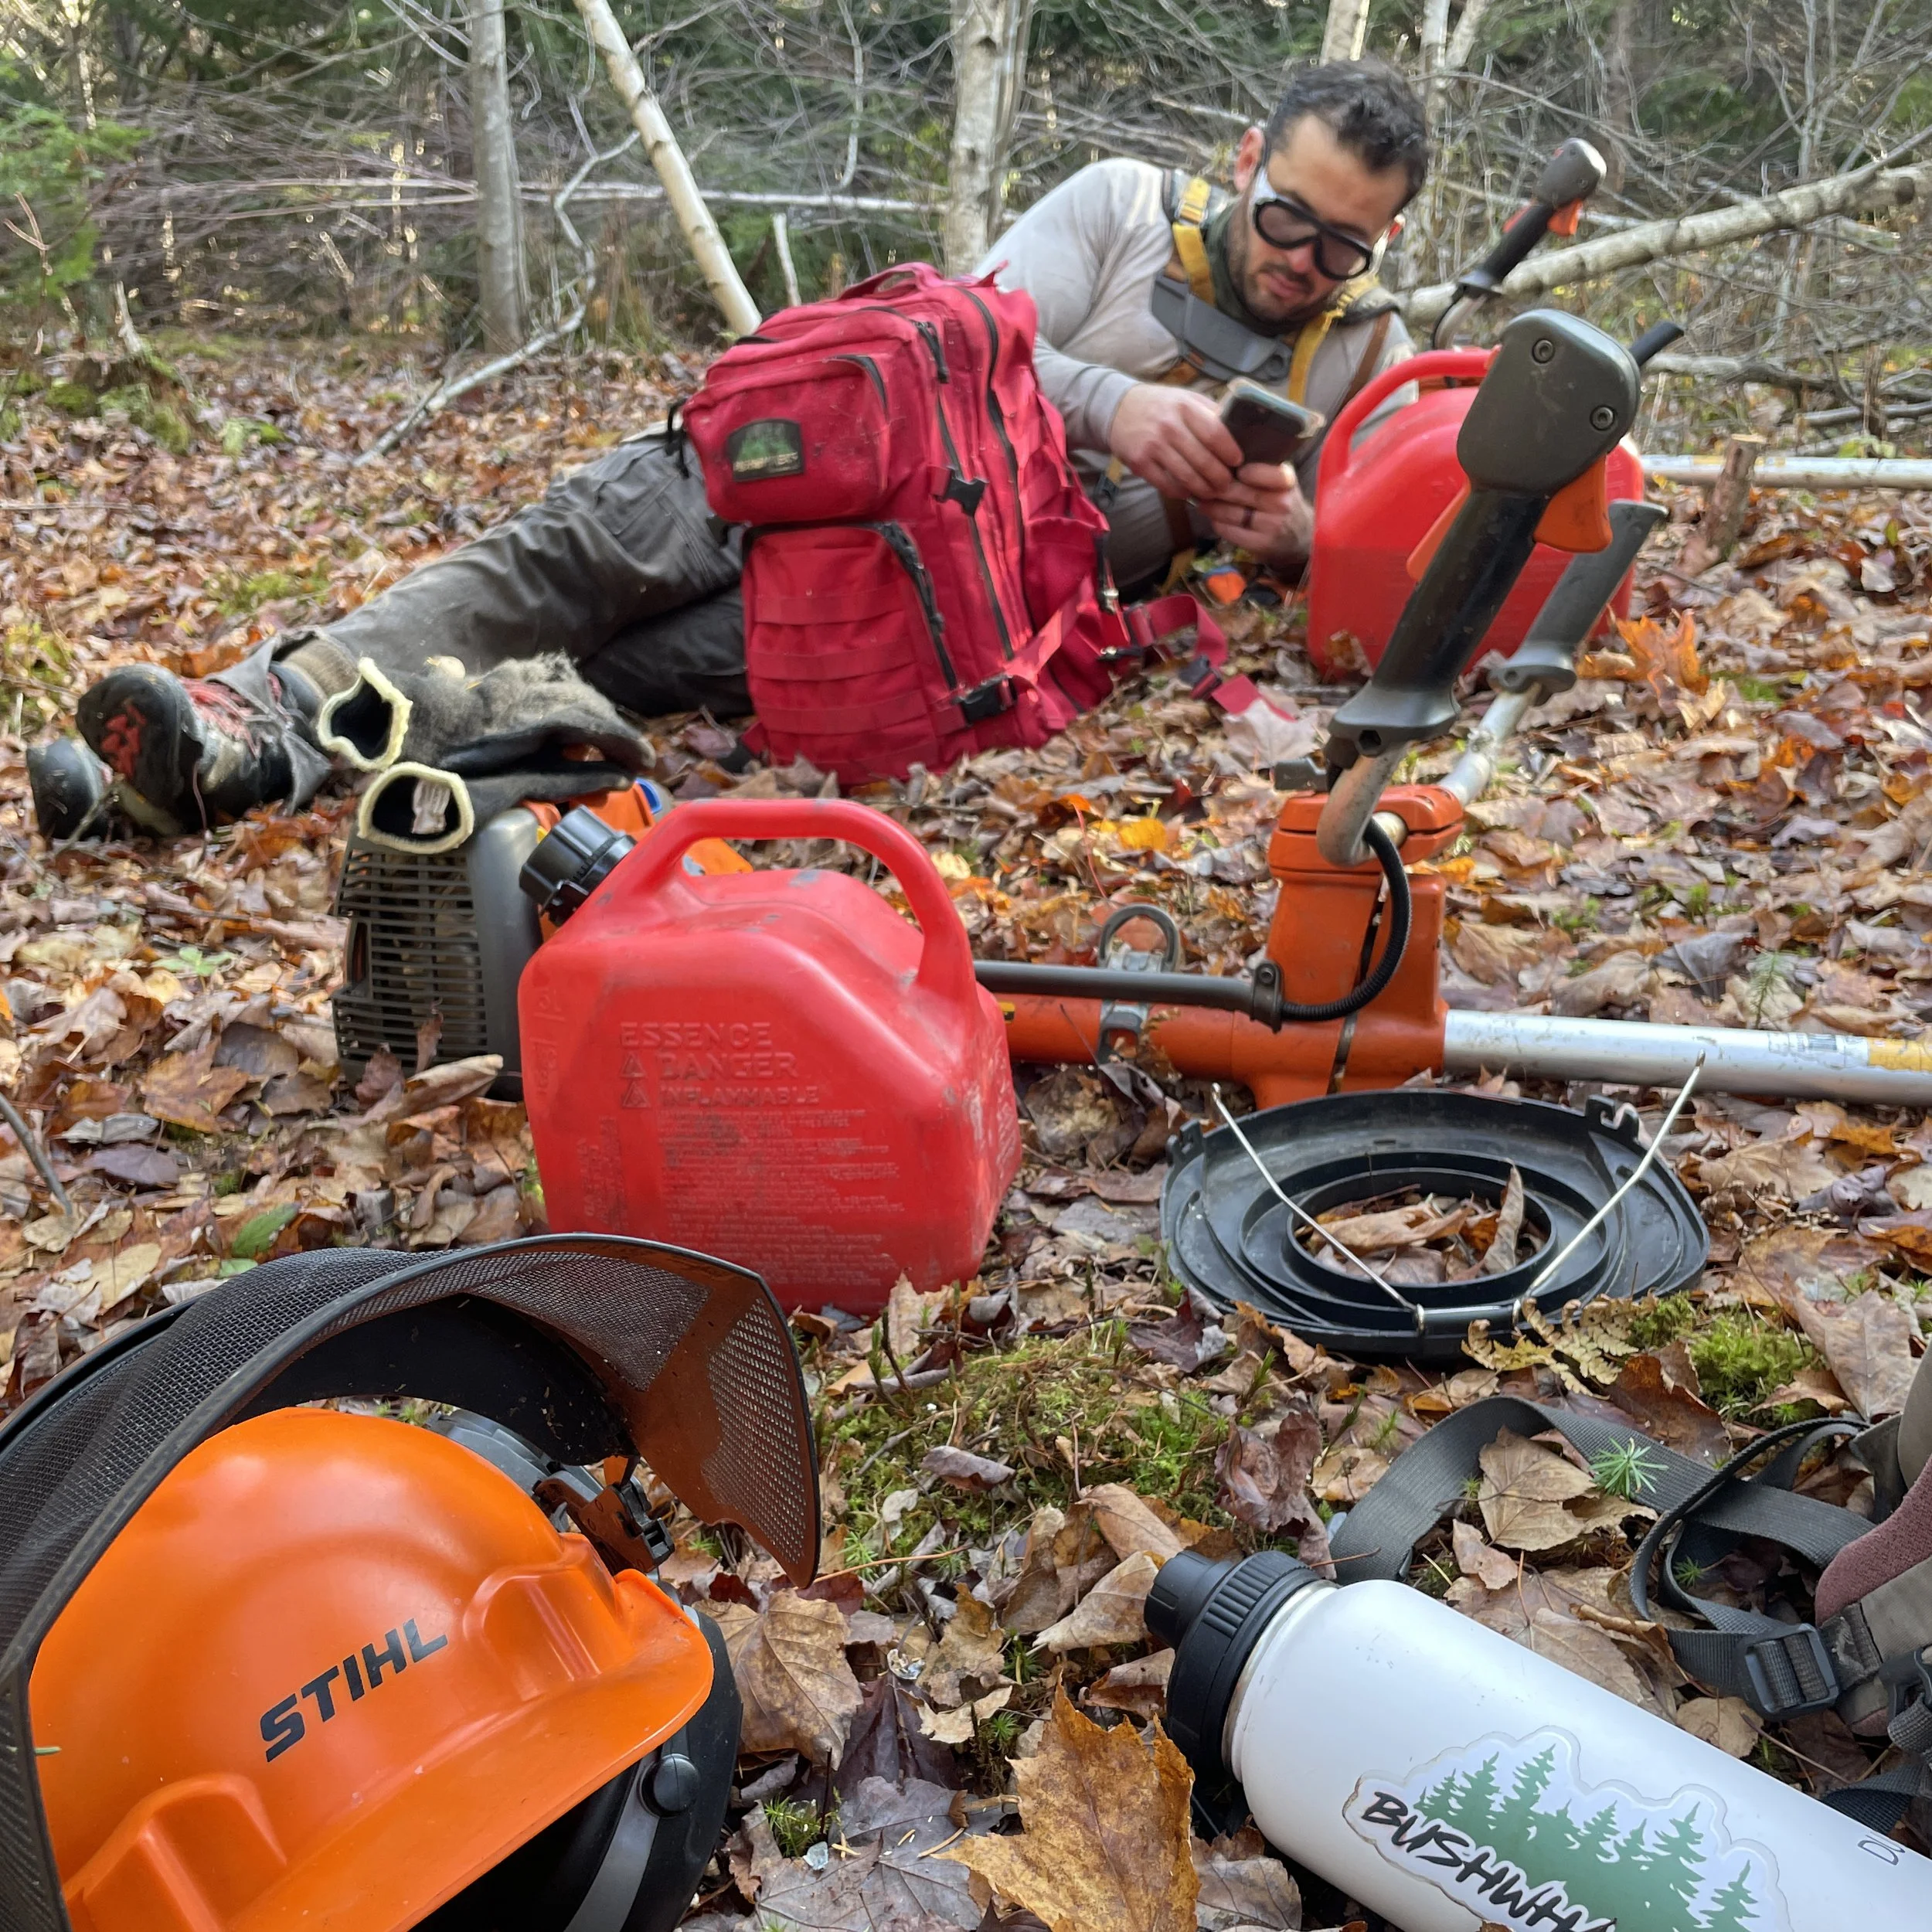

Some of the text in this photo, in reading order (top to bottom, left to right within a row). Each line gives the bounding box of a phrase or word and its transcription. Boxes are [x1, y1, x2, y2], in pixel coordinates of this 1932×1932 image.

[620, 1022, 772, 1049] ESSENCE
[657, 1052, 800, 1080] DANGER
[660, 1085, 820, 1106] INFLAMMABLE
[260, 1617, 448, 1763] STIHL
